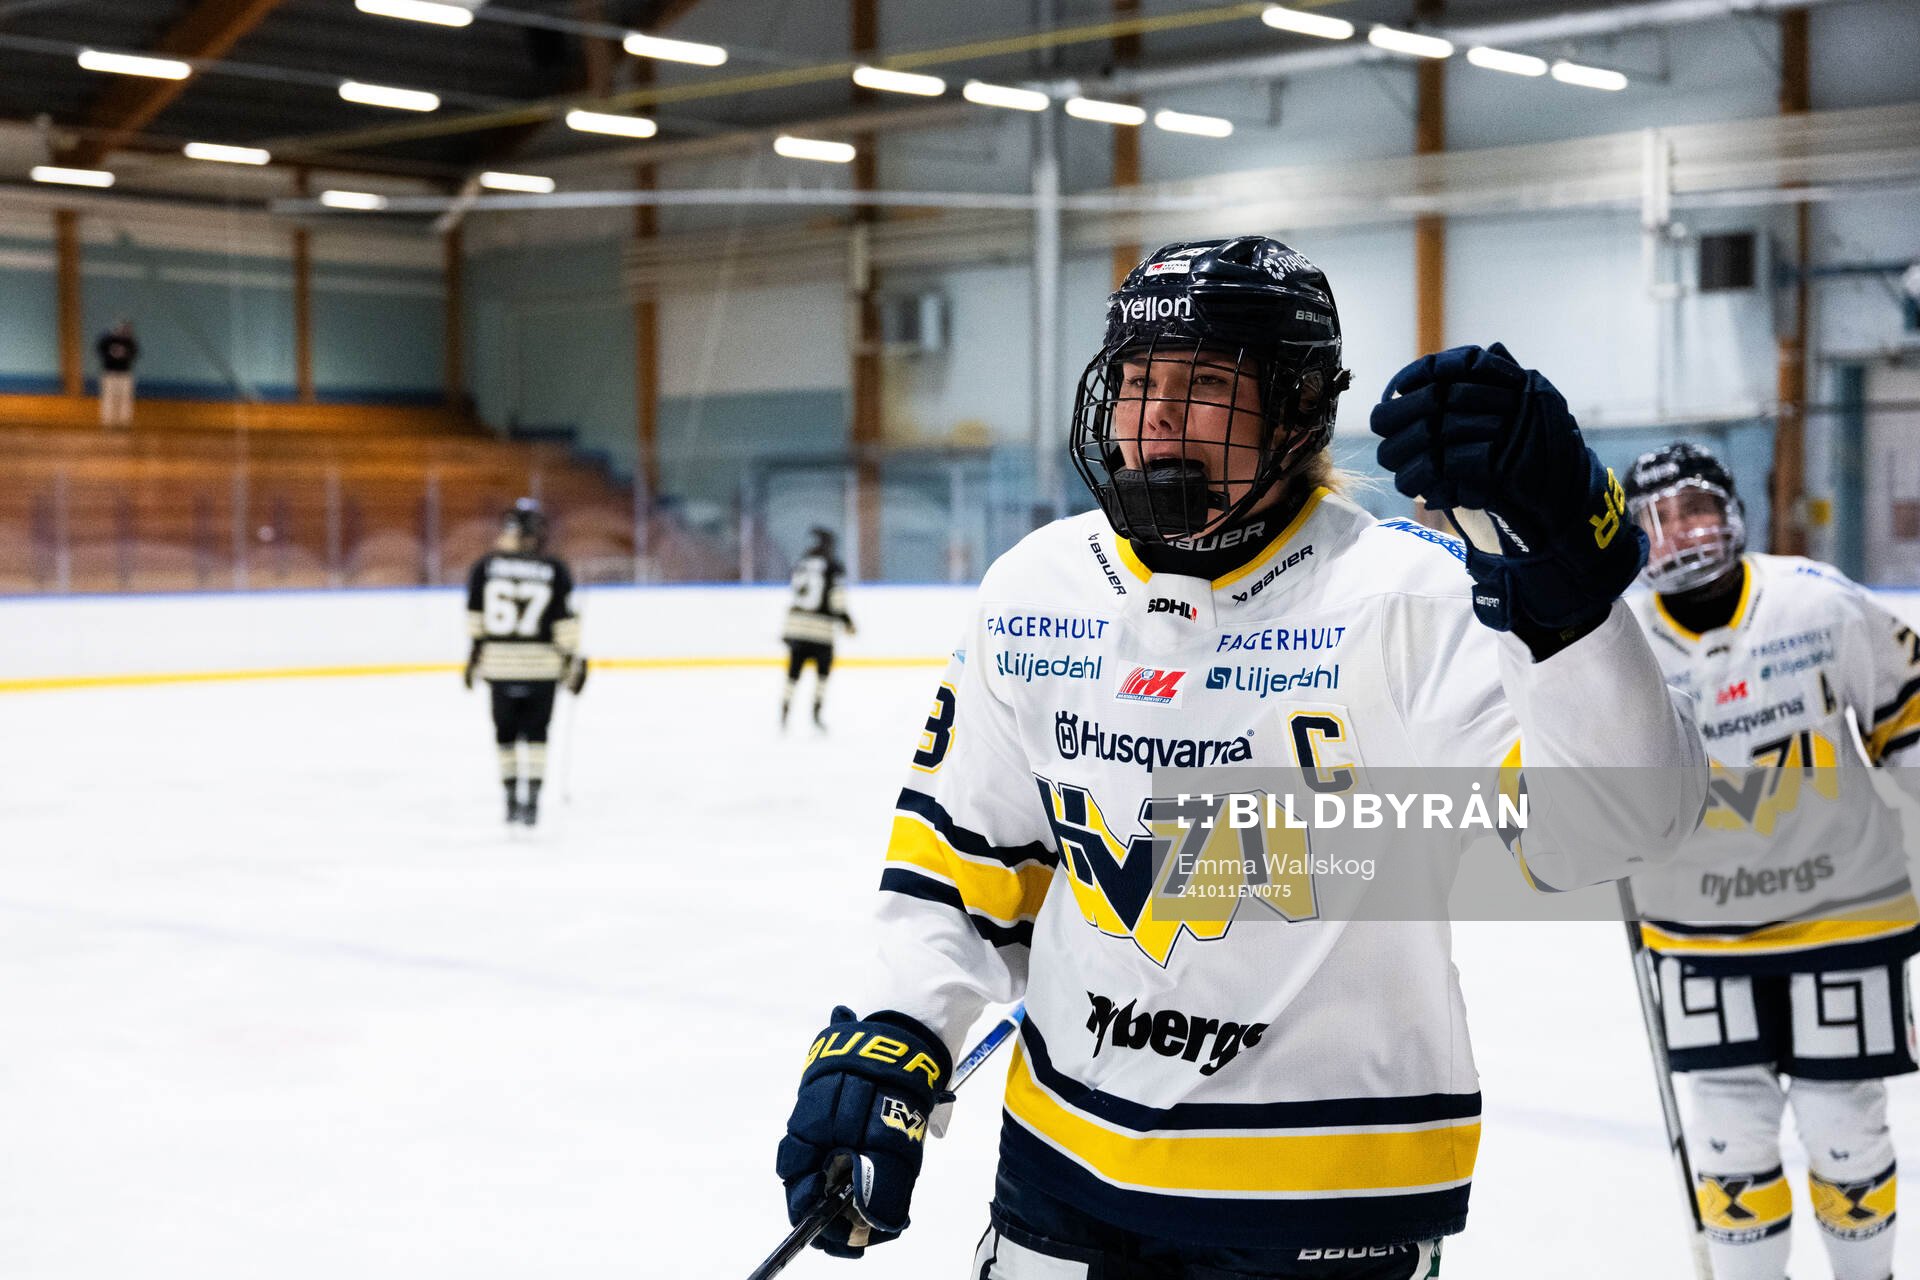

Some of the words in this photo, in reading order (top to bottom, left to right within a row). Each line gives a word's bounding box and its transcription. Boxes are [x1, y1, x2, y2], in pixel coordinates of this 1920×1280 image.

[1120, 296, 1191, 323] Yellon
[1167, 521, 1266, 552] AUER
[1251, 544, 1314, 597] BAUER
[483, 578, 553, 637] 67
[987, 615, 1109, 639] FAGERHULT
[1216, 626, 1346, 653] FAGERHULT
[1004, 650, 1102, 682] Liljedahl
[1081, 720, 1253, 774] Husqvarna
[1288, 711, 1358, 795] C
[1701, 854, 1835, 906] nybergs
